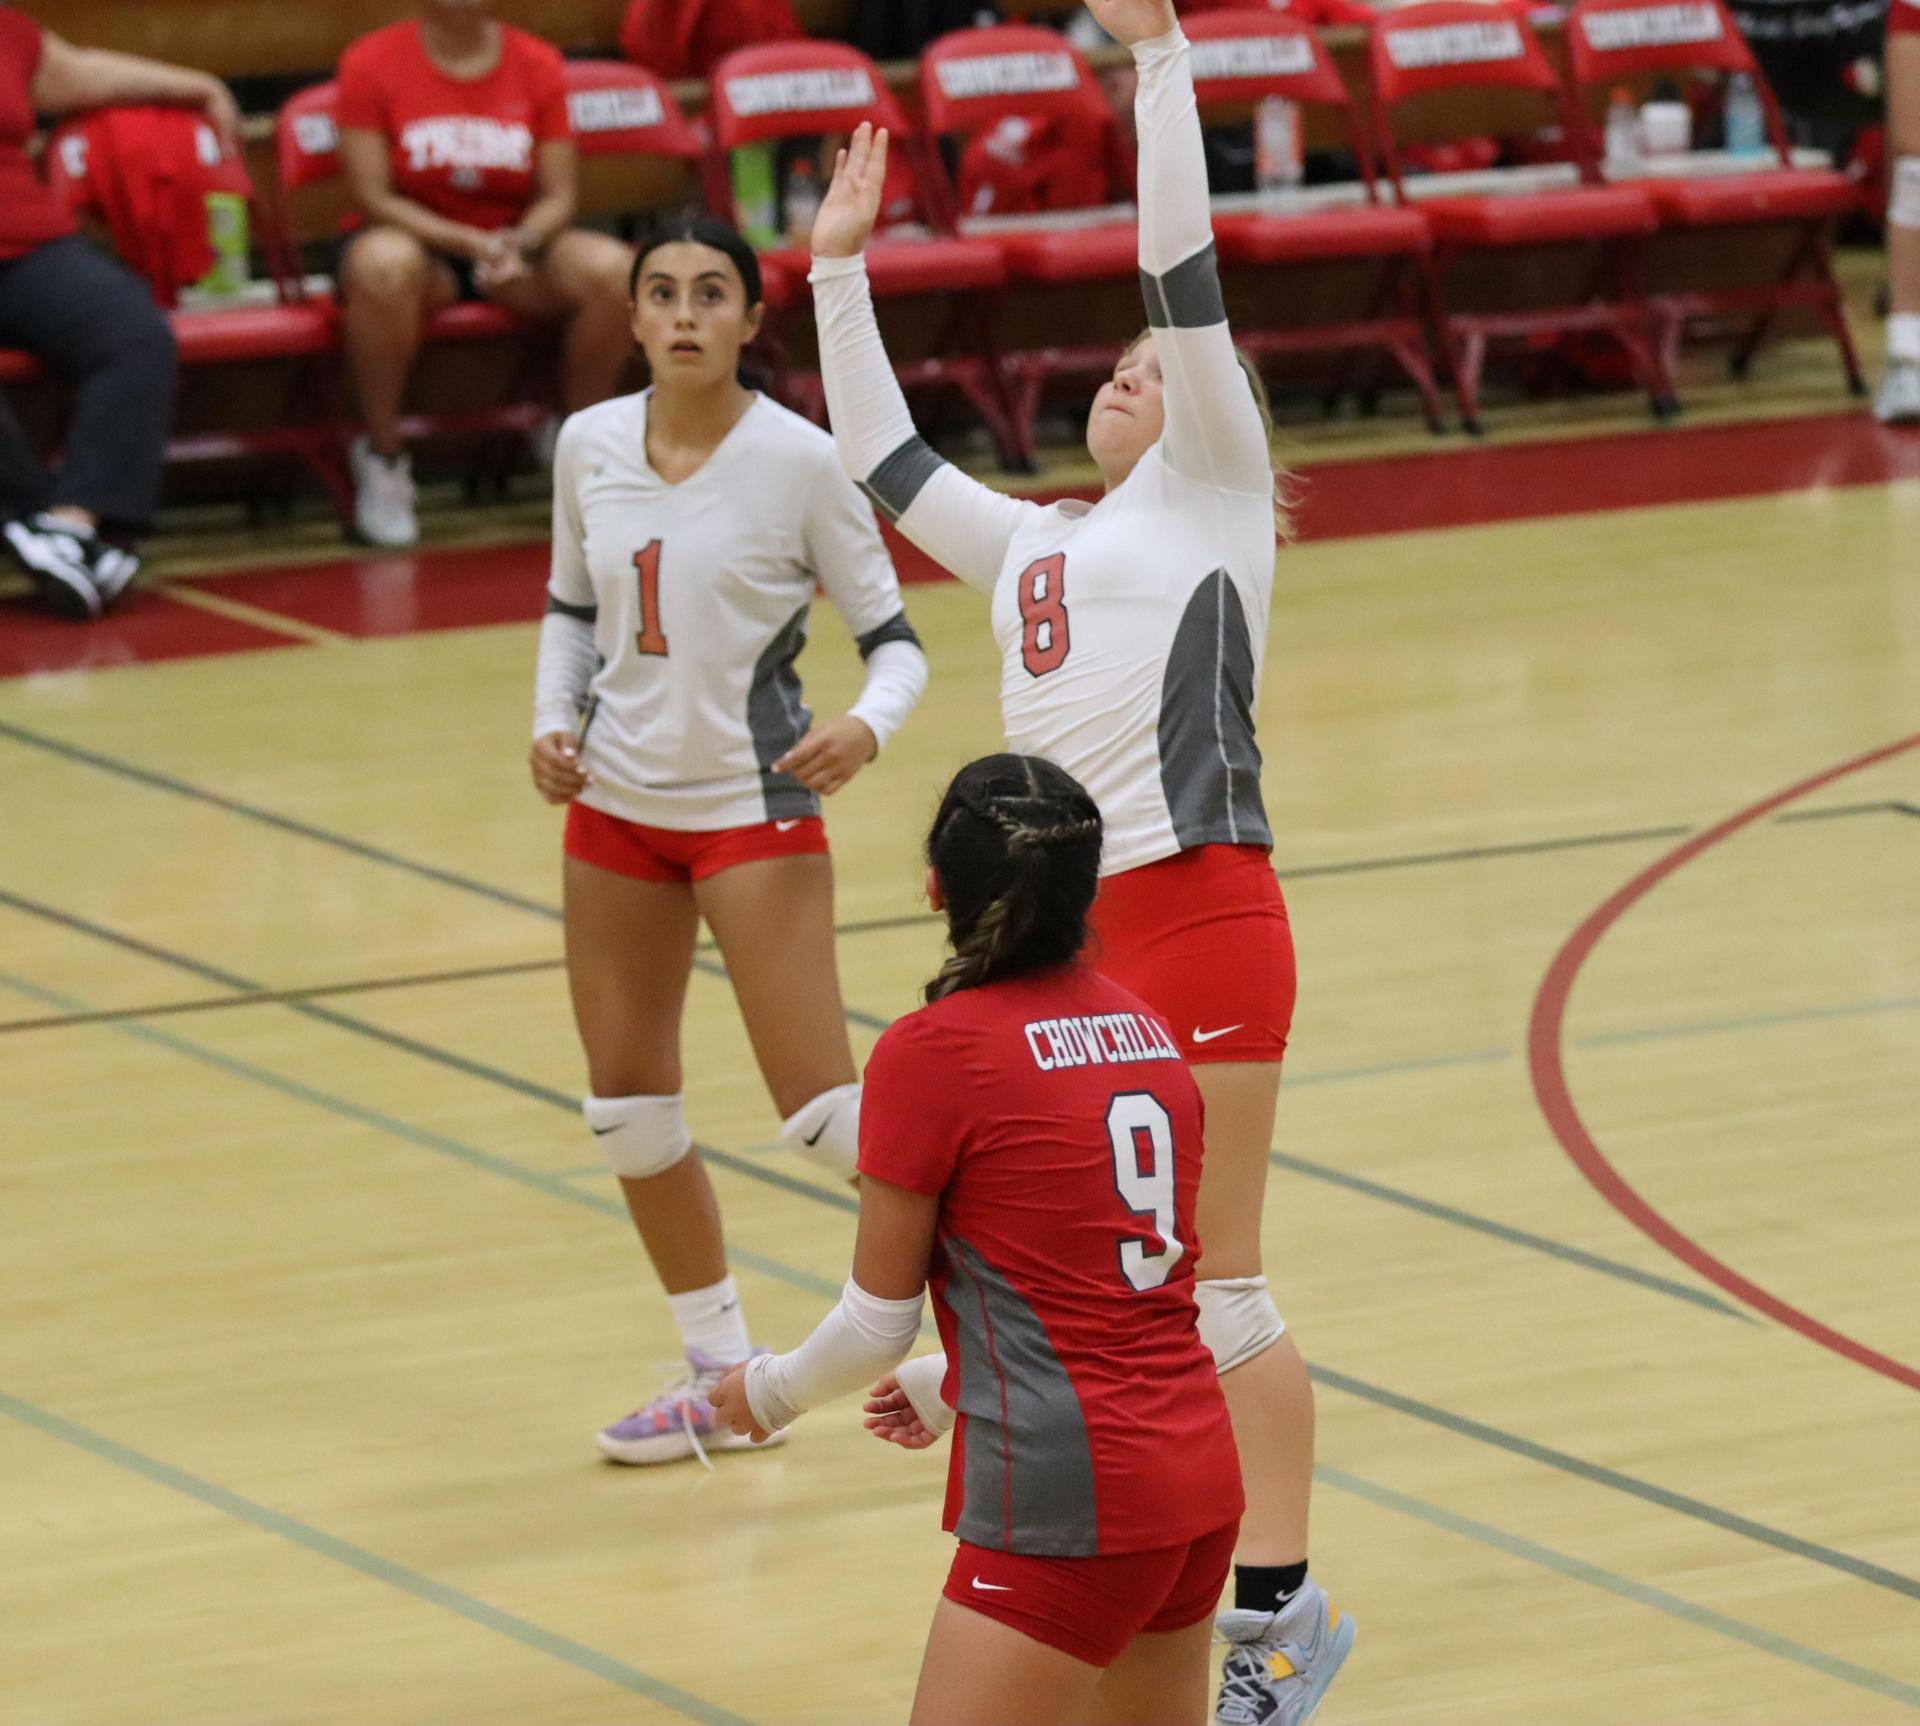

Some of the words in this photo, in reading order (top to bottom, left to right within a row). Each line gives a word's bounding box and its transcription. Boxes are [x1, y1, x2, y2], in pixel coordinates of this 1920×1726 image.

[633, 538, 669, 657] 1
[1018, 550, 1071, 678] 8
[1104, 1089, 1185, 1293] 9
